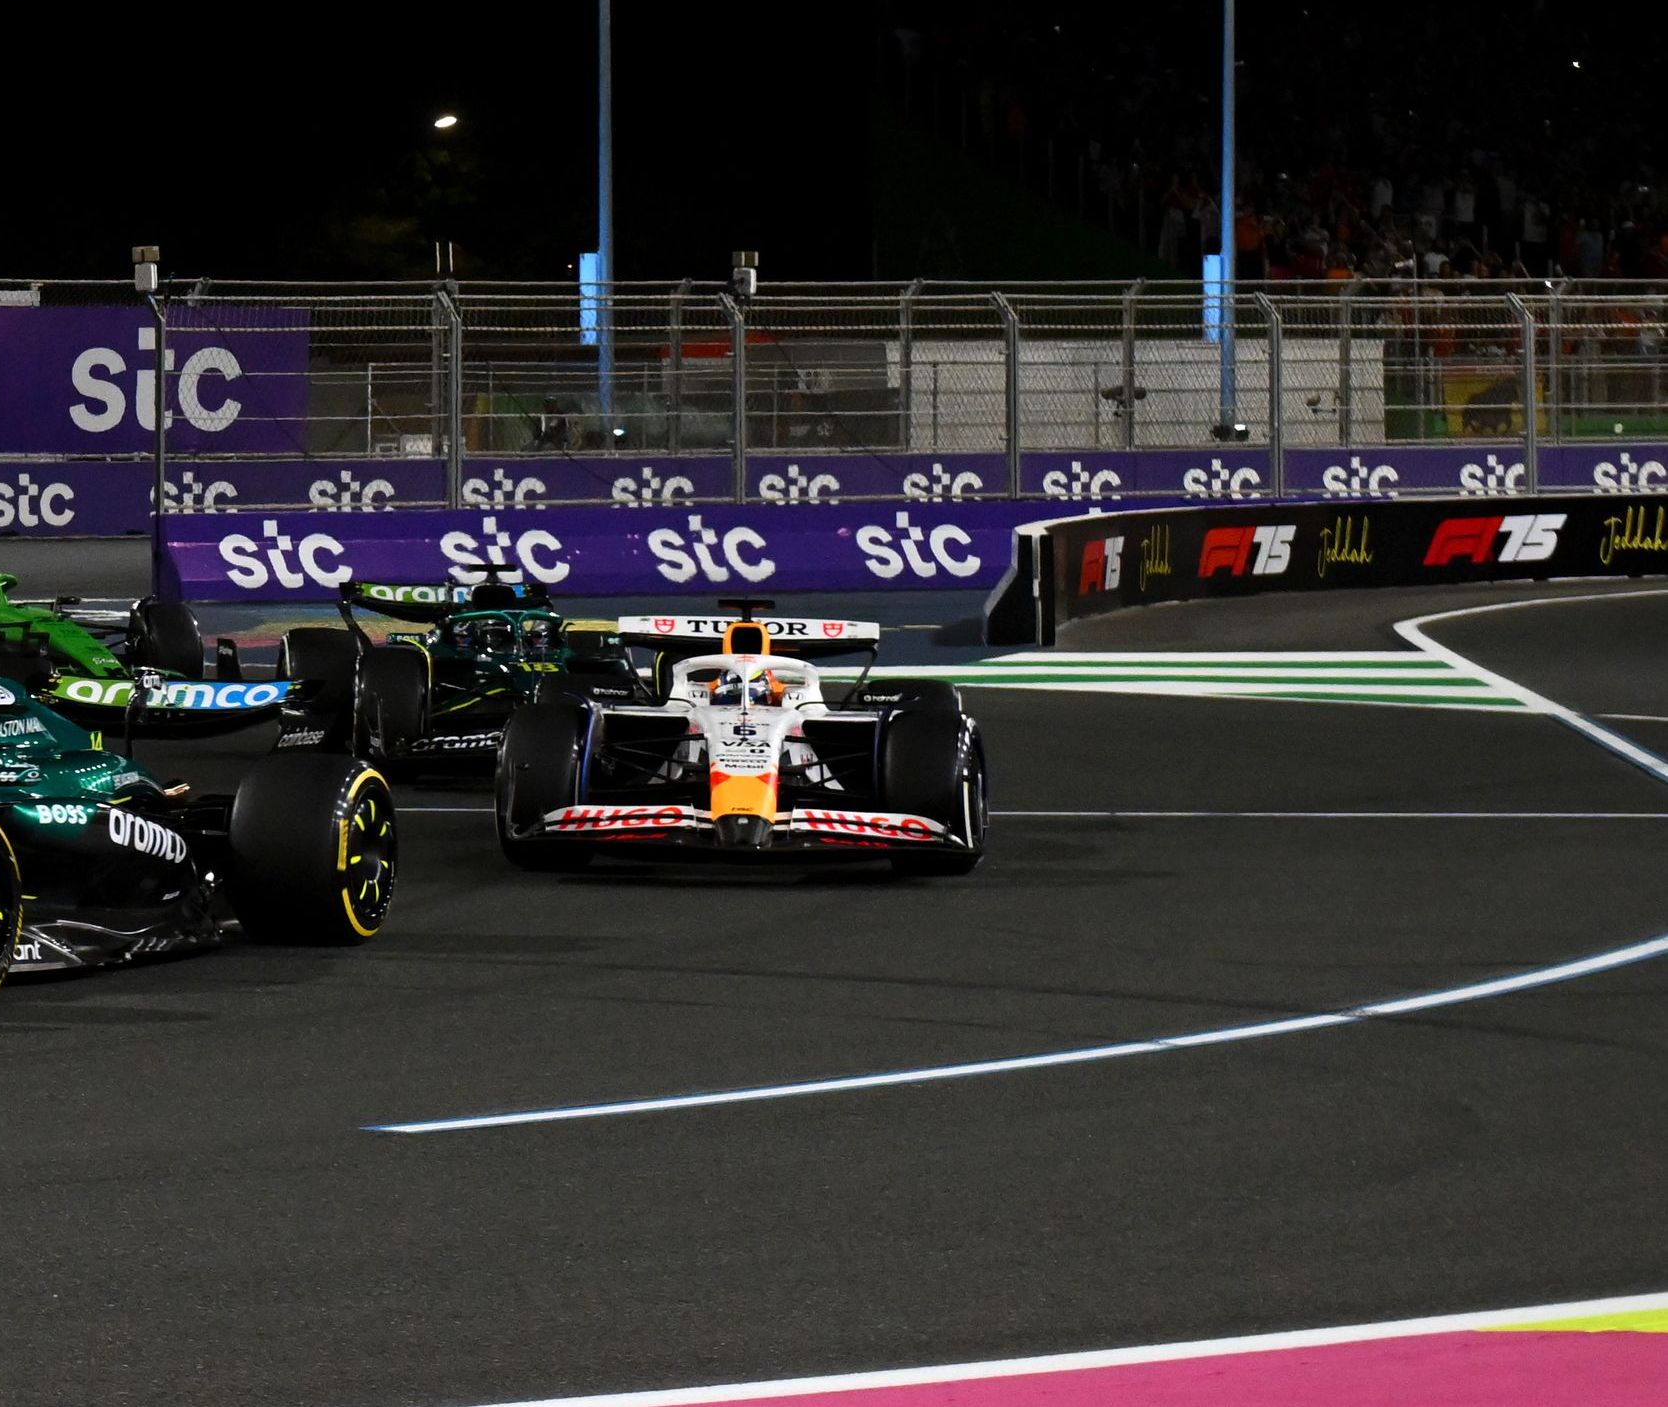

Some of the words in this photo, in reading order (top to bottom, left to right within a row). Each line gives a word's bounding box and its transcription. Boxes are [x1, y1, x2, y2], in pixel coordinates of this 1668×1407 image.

[69, 327, 243, 433] stc
[150, 471, 237, 513] stc
[309, 470, 394, 513] stc
[463, 468, 546, 510] stc
[612, 467, 694, 508] stc
[759, 464, 840, 505] stc
[903, 463, 983, 503] stc
[1043, 461, 1121, 500] stc
[1183, 458, 1261, 499] stc
[1322, 456, 1399, 499] stc
[1459, 454, 1526, 497] stc
[1593, 452, 1667, 494] stc
[219, 520, 353, 589] stc
[440, 516, 570, 584] stc
[647, 515, 776, 583] stc
[856, 511, 981, 578] stc
[1317, 514, 1375, 580] Jeddah
[369, 583, 474, 604] aram
[687, 620, 810, 636] TUOR
[90, 731, 104, 751] 14
[277, 727, 326, 748] coinbase
[733, 725, 757, 737] 6
[721, 741, 771, 749] VISA
[36, 804, 88, 825] BOSS
[559, 806, 683, 831] HUGO
[804, 810, 933, 841] HUGO
[108, 808, 187, 864] aramco
